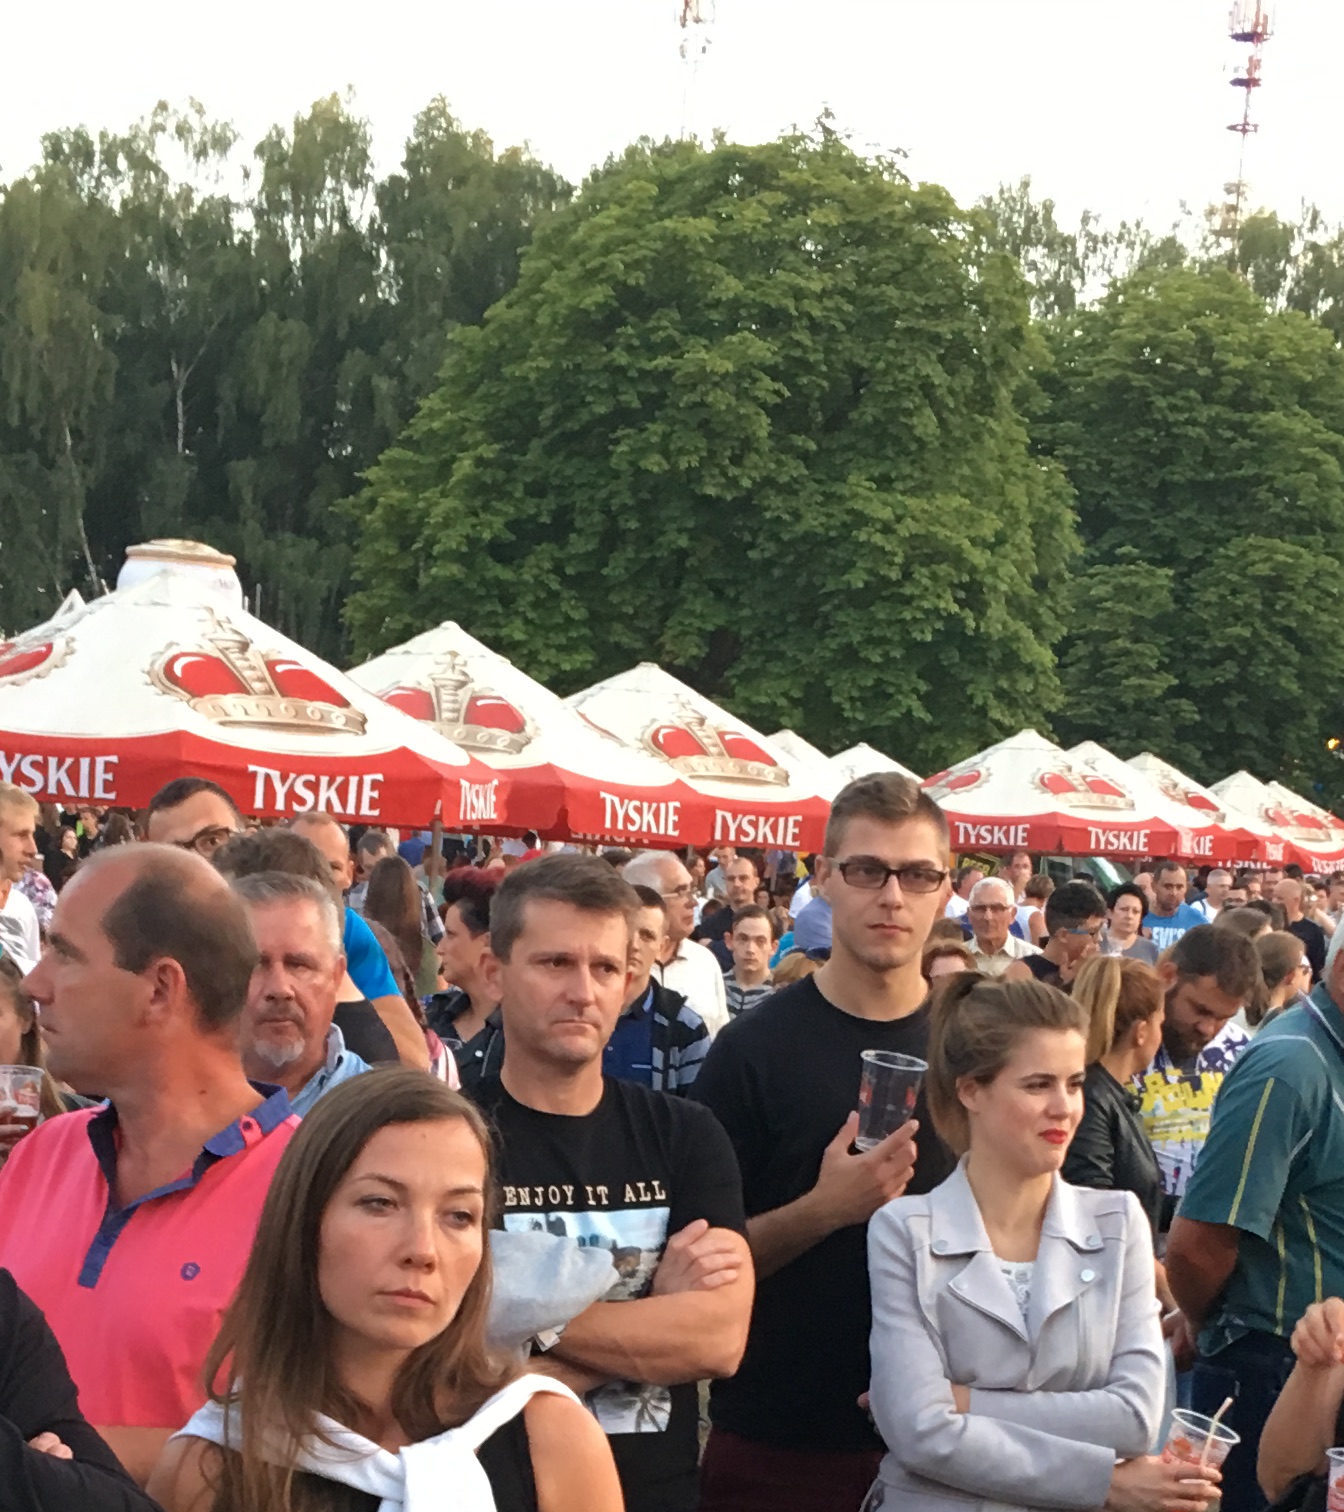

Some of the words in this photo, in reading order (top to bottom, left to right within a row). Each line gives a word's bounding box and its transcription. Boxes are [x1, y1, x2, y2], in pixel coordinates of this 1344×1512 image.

[247, 764, 384, 816] TYSKIE
[459, 778, 499, 820] TYSKIE
[600, 791, 681, 837] TYSKIE
[714, 809, 803, 847] TYSKIE
[954, 821, 1030, 847] TYSKIE
[1087, 826, 1151, 852] TYSKIE
[503, 1185, 574, 1206] ENJOY
[585, 1185, 609, 1206] IT
[624, 1180, 666, 1203] ALL
